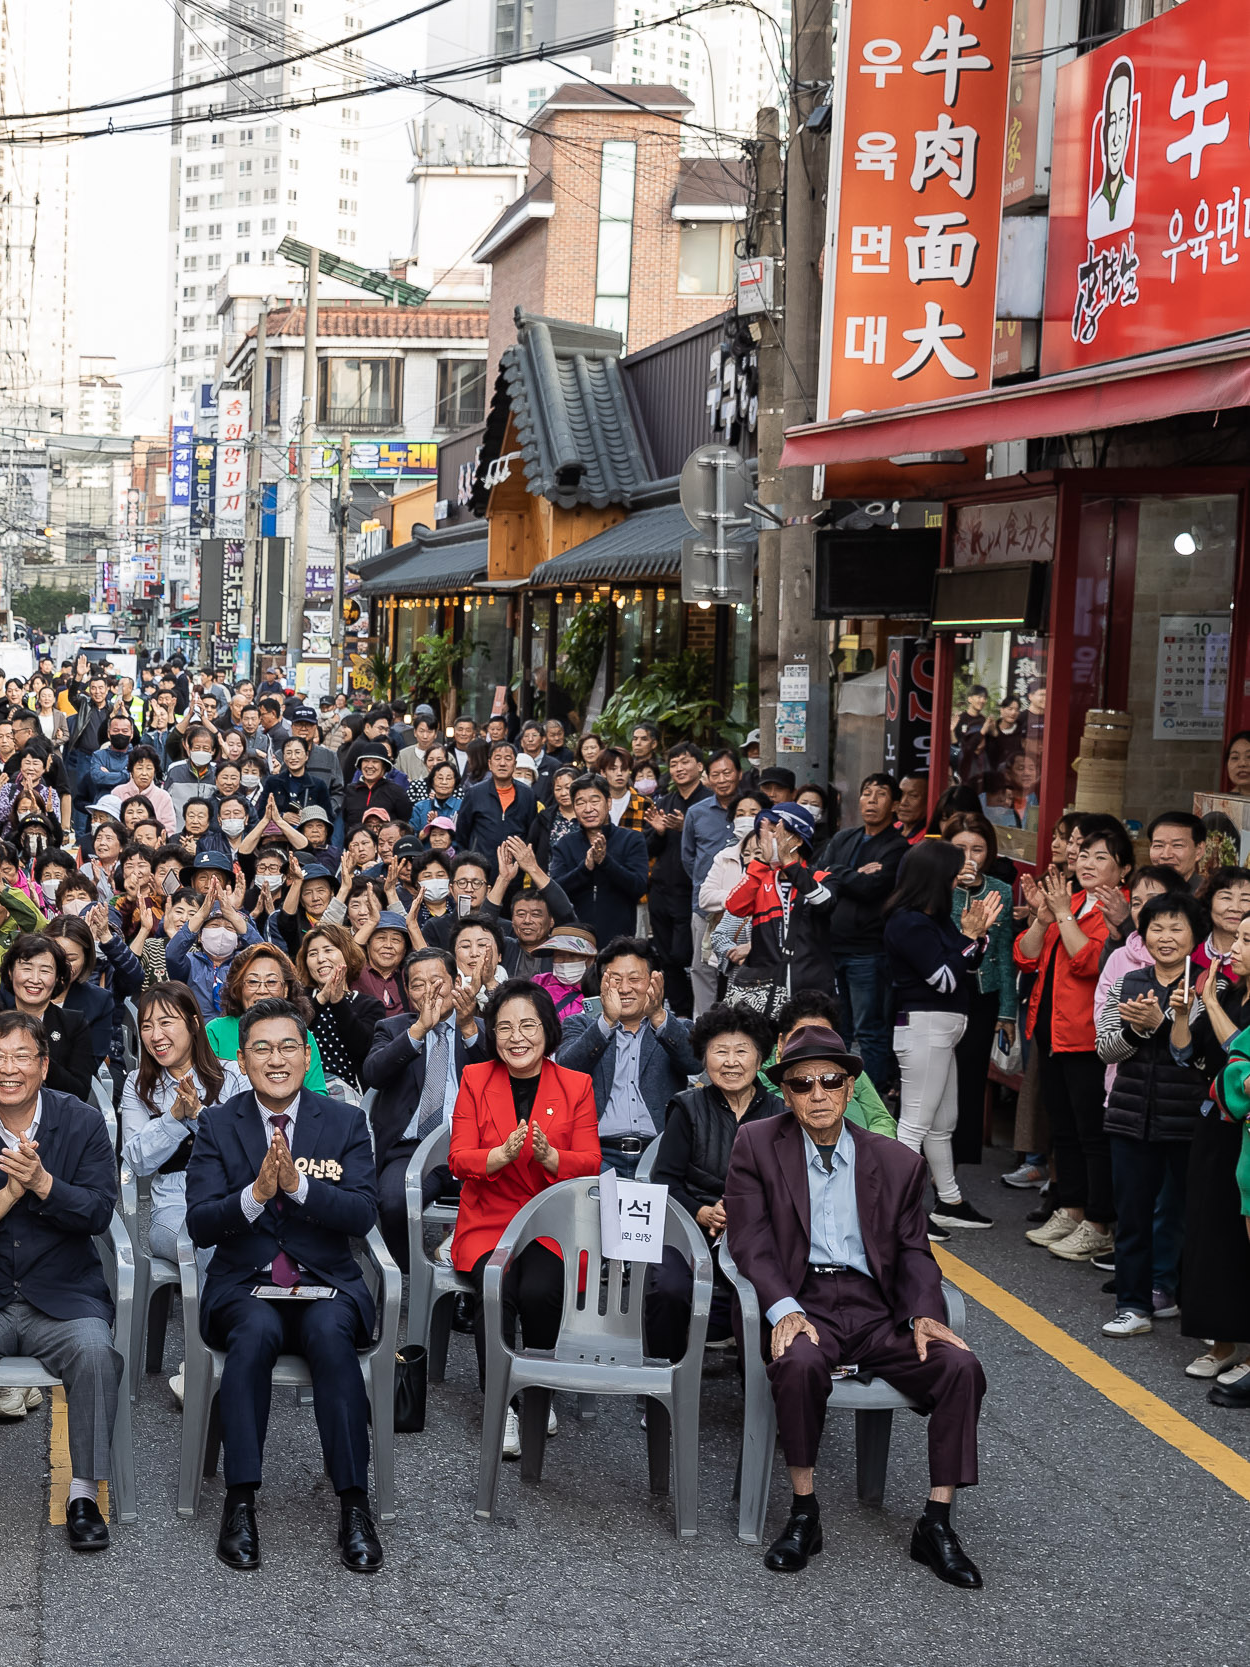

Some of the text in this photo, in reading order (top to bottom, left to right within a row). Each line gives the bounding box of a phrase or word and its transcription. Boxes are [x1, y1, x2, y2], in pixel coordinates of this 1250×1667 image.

[1166, 59, 1230, 180] 牛
[843, 38, 903, 418] 우육면대
[892, 0, 993, 408] 牛肉面大
[222, 399, 243, 511] 송화양꼬치
[379, 443, 438, 469] 노래
[1193, 622, 1212, 637] 10
[886, 649, 900, 722] S
[294, 1156, 343, 1181] 오신환
[618, 1198, 652, 1226] 석
[634, 1231, 652, 1243] 의장
